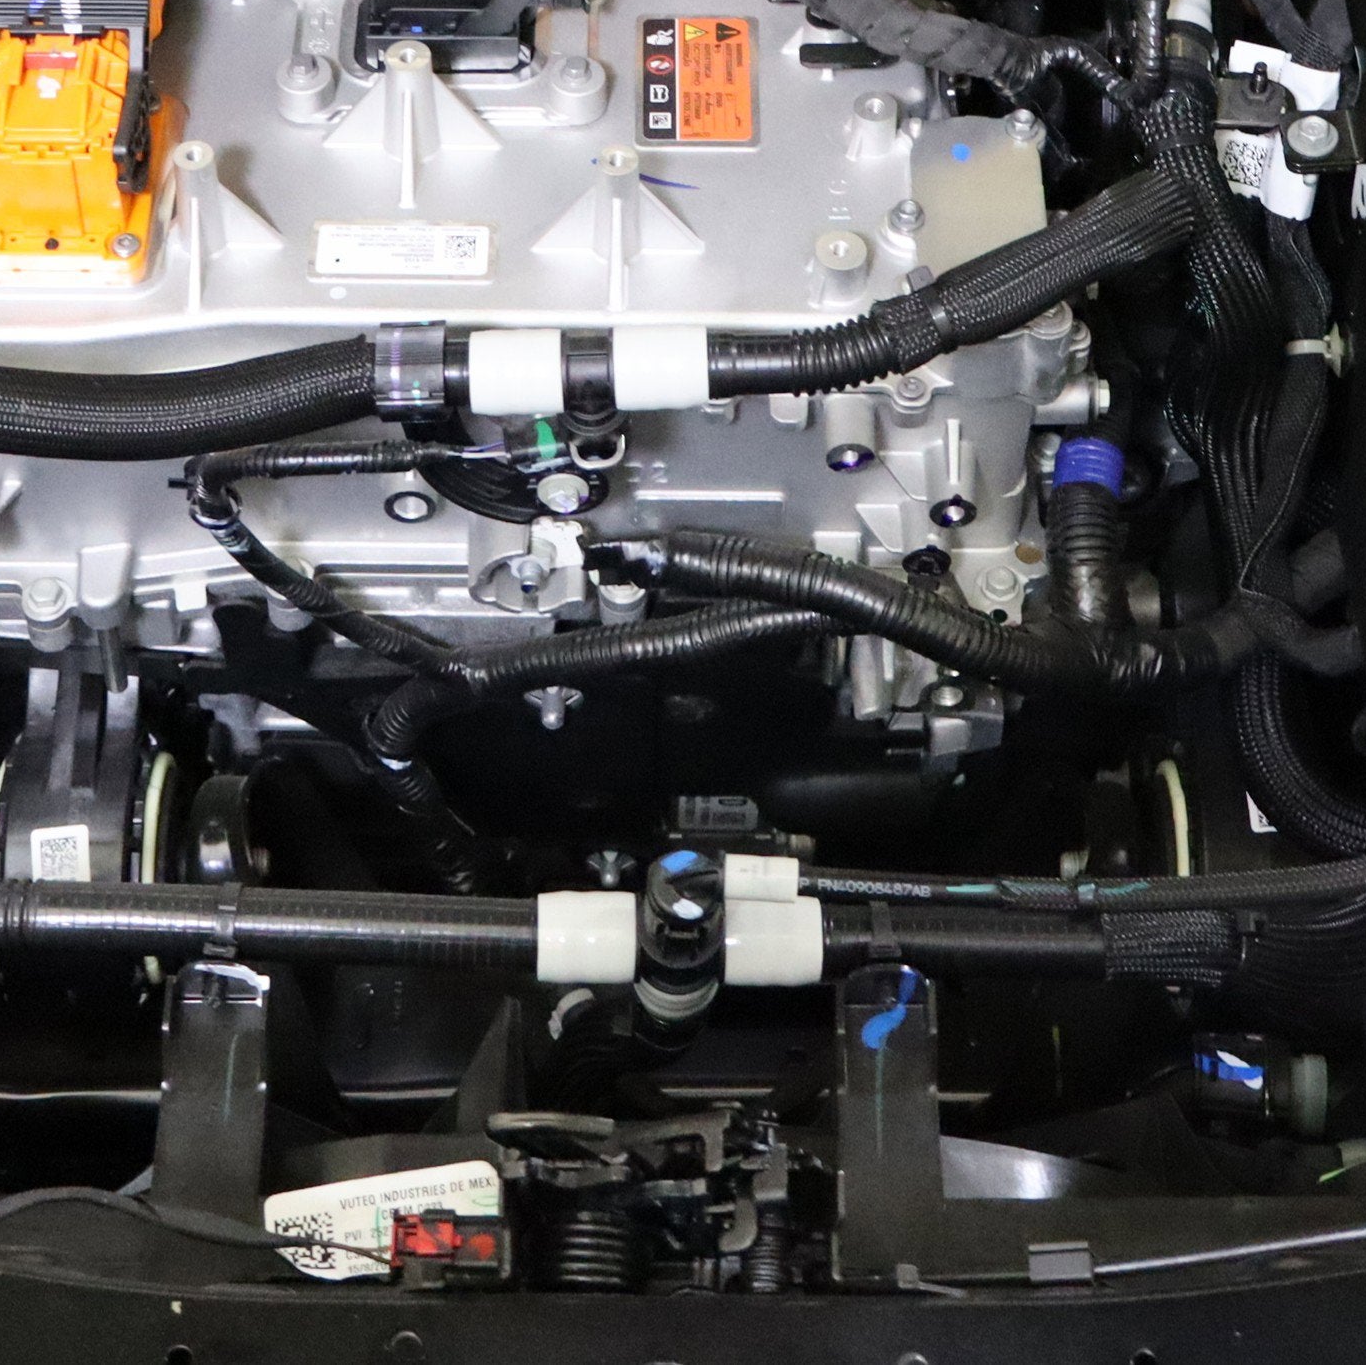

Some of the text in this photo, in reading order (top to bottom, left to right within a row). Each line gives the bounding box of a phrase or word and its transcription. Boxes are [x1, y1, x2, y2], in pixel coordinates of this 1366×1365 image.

[339, 1193, 378, 1211] VUTEQ
[379, 1184, 448, 1204] INDUSTRIES
[450, 1181, 466, 1194] DE
